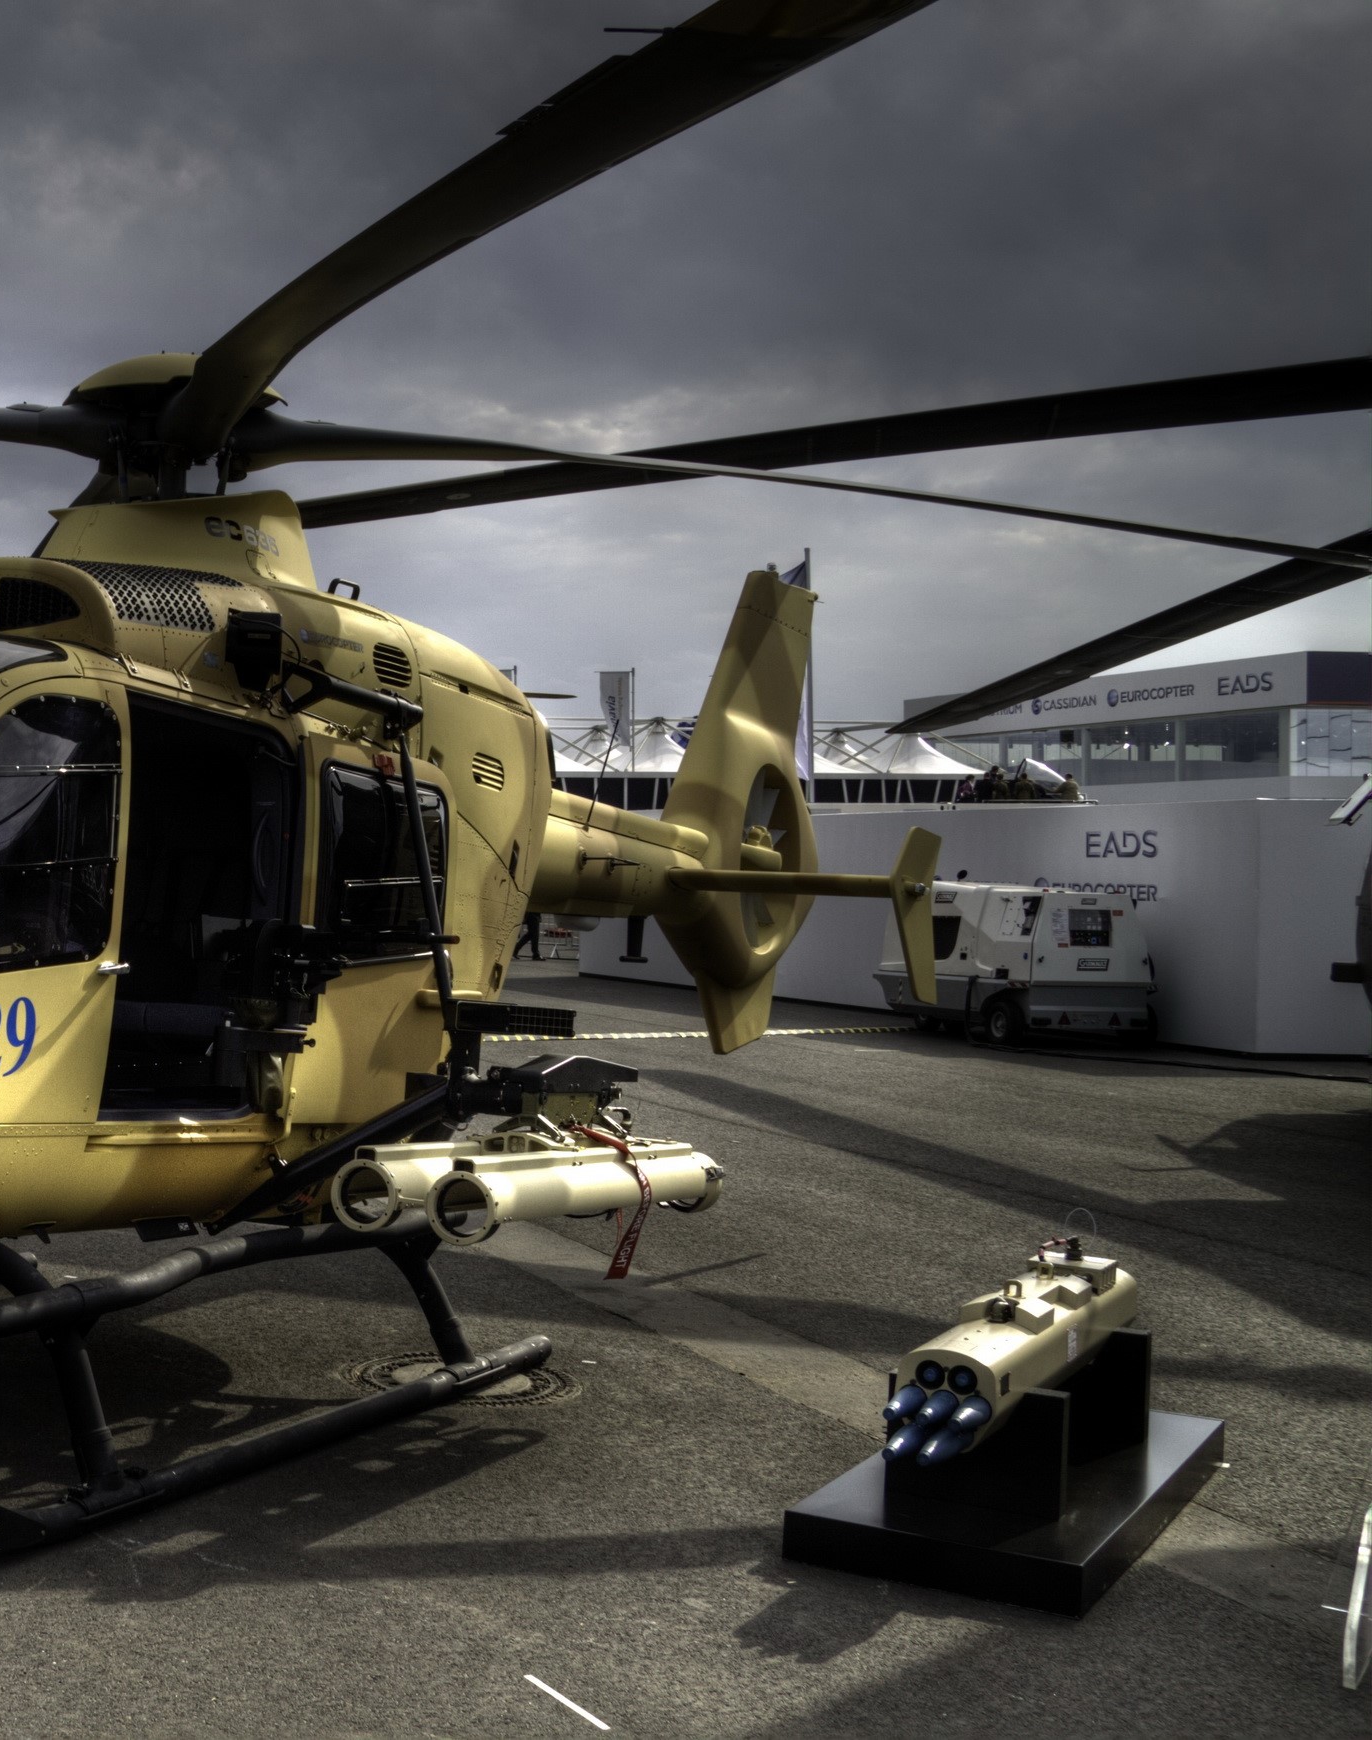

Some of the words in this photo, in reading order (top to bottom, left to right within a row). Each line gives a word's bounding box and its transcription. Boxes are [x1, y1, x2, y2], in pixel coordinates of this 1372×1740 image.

[1120, 684, 1195, 703] EUROCOPTER
[1217, 671, 1274, 697] EADS
[1042, 694, 1097, 711] CASSIDIAN
[1085, 829, 1158, 858] EADS
[614, 1232, 638, 1269] FLIGHT
